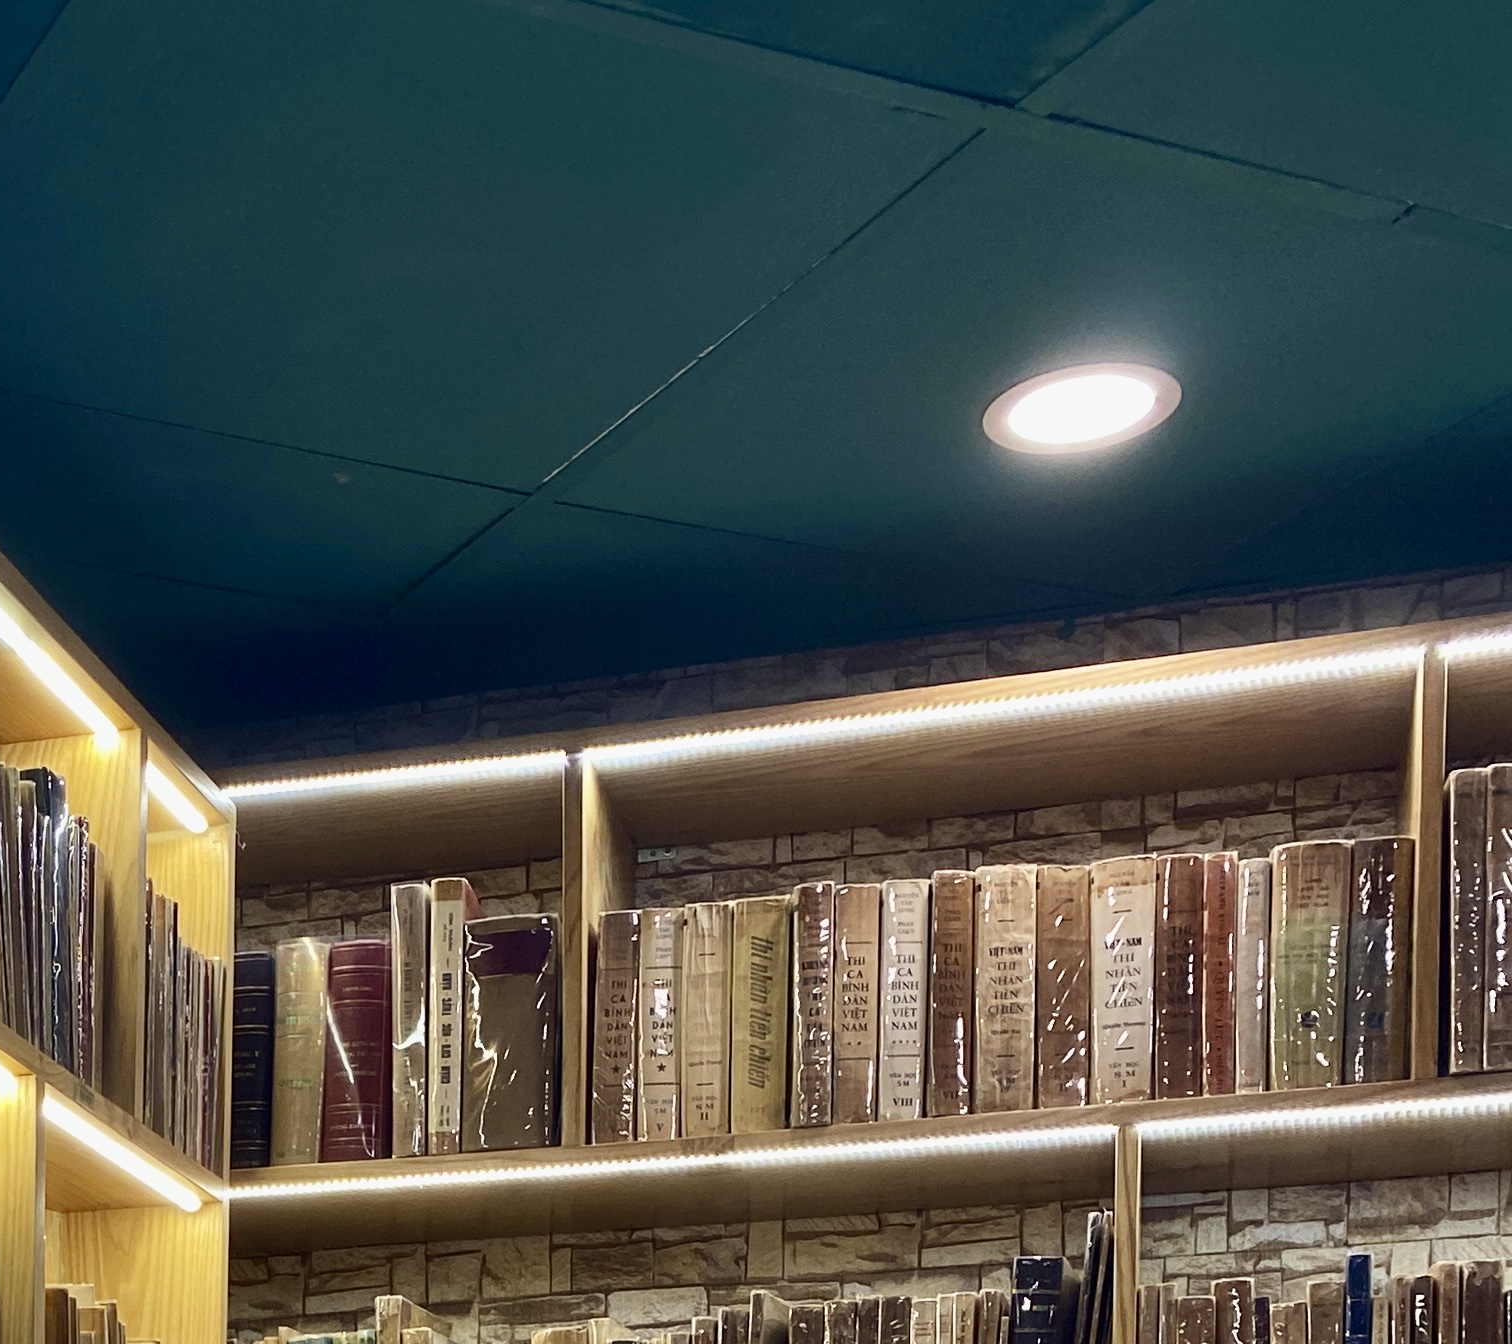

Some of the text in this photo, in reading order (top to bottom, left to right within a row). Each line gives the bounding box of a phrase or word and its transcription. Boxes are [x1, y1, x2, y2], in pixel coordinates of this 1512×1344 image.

[845, 955, 866, 966] THI
[895, 954, 916, 964] THI
[943, 957, 961, 967] CA
[1112, 952, 1135, 963] THI
[996, 961, 1017, 971] THI
[847, 970, 864, 979] CA
[897, 967, 914, 977] CA
[612, 980, 627, 989] THI
[891, 979, 919, 991] BÌNH
[610, 994, 626, 1003] CA
[842, 1008, 868, 1019] VIỆT
[892, 1007, 917, 1019] VIỆT
[842, 1023, 868, 1032] NAM
[891, 1021, 918, 1031] NAM
[605, 1050, 628, 1058] NAM
